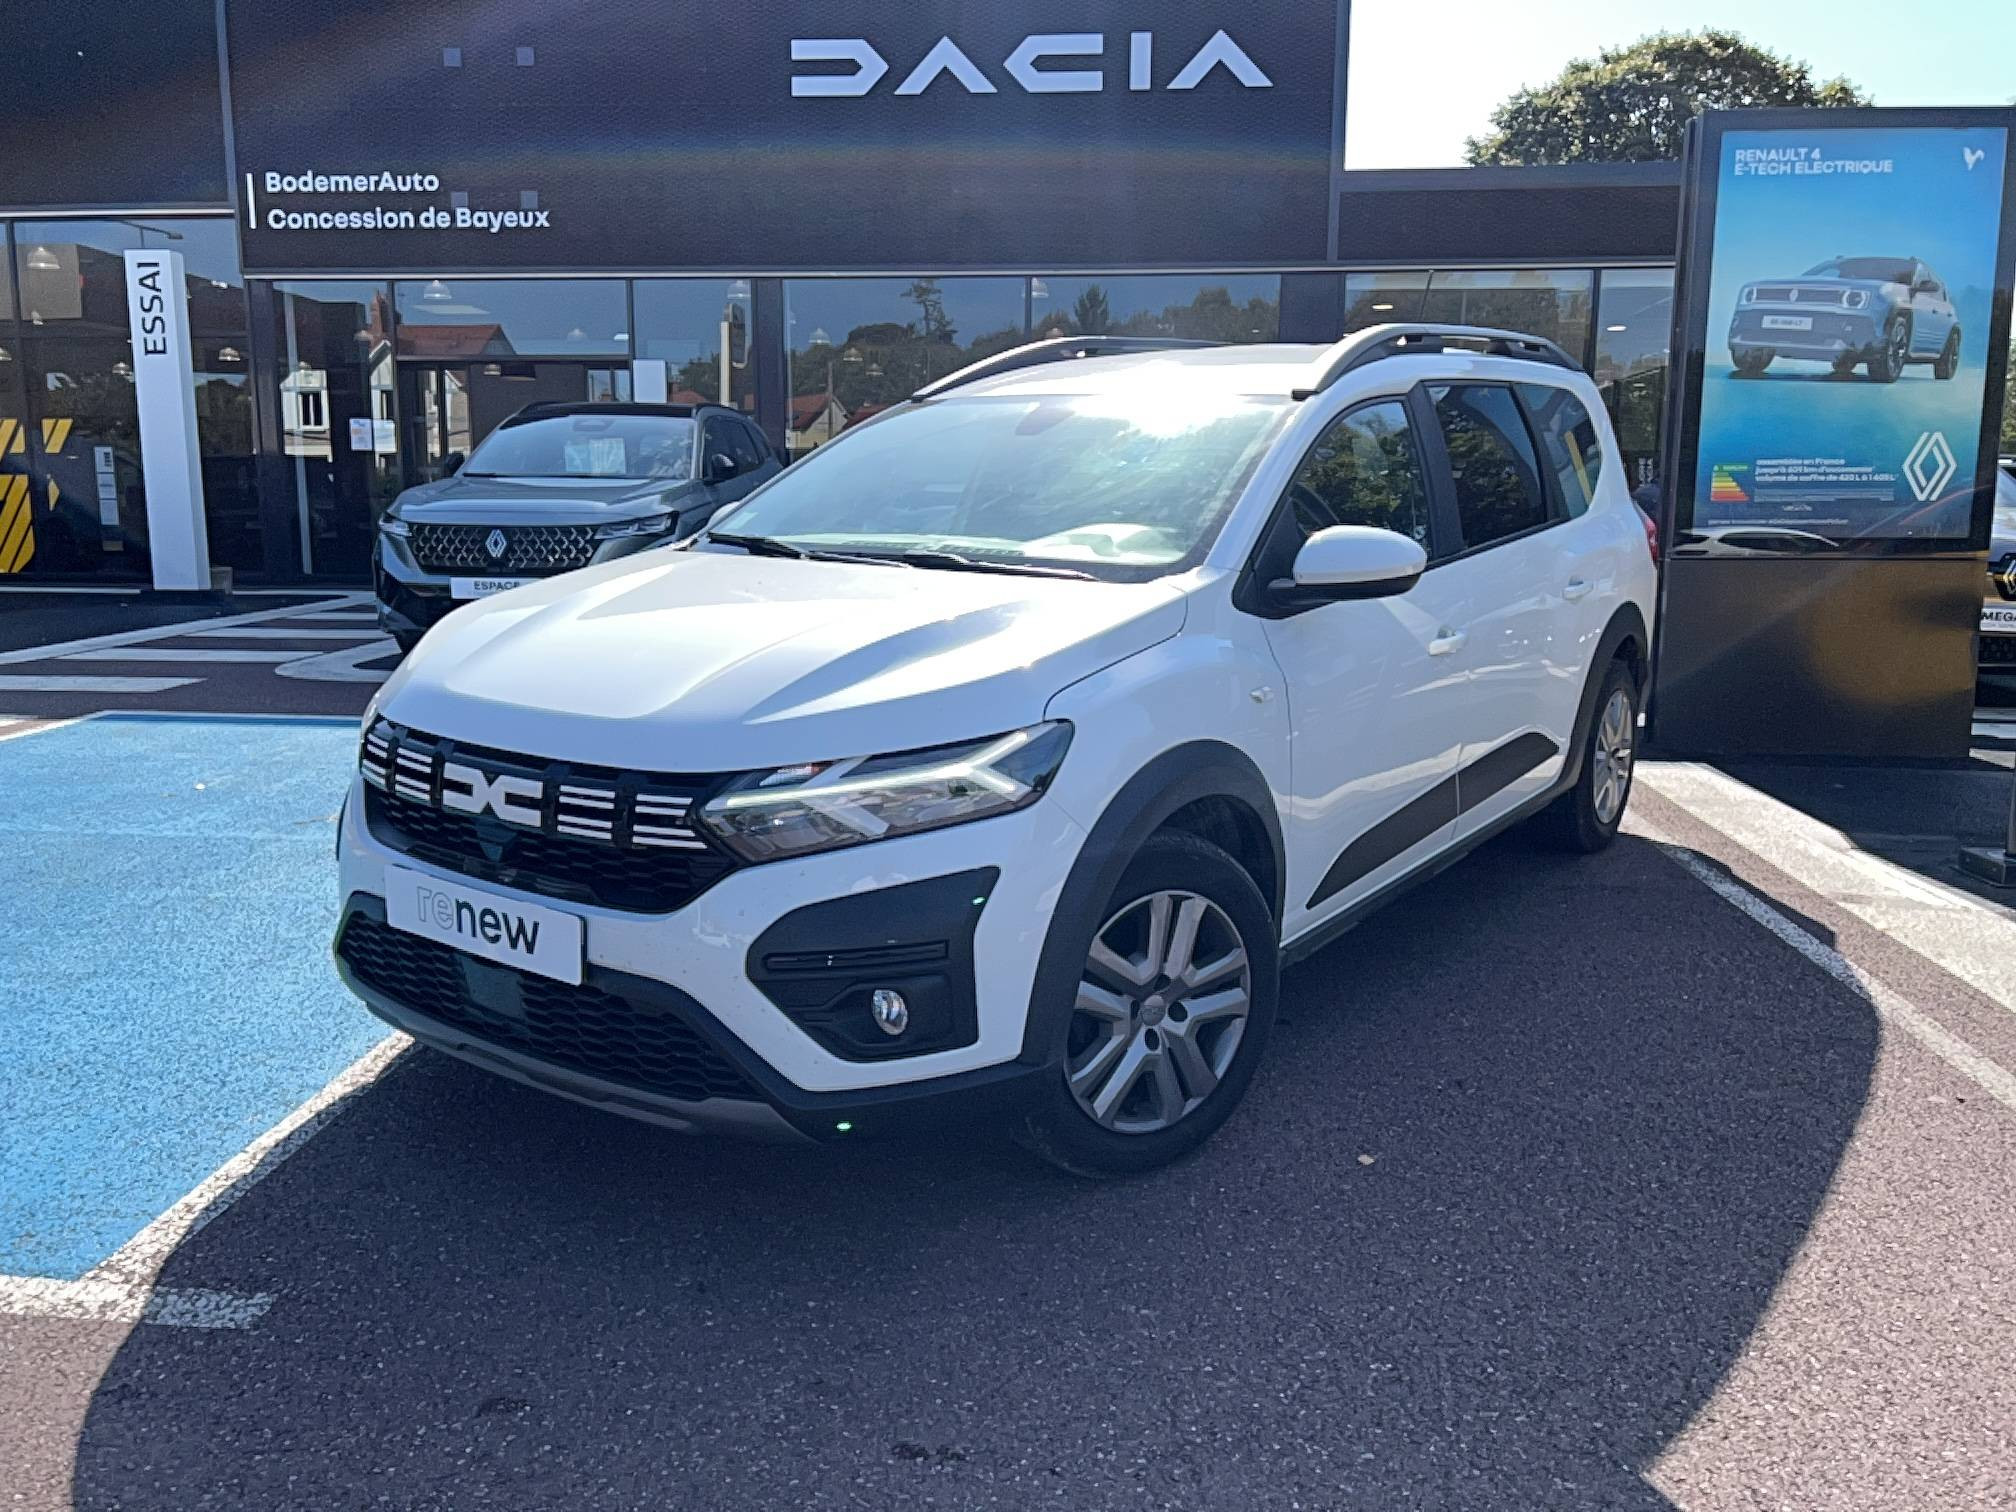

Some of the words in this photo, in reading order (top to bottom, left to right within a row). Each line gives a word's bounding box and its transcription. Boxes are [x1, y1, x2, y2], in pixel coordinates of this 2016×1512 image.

[791, 29, 1274, 97] DACIA
[1735, 148, 1808, 161] RENAULT
[1810, 148, 1821, 160] 4
[265, 171, 439, 192] BodemerAuto
[1734, 162, 1791, 176] E-TECH
[268, 207, 415, 229] Concession
[419, 207, 451, 228] de
[456, 207, 550, 233] Bayeux
[137, 261, 167, 355] ESSAI
[416, 886, 540, 955] renew
